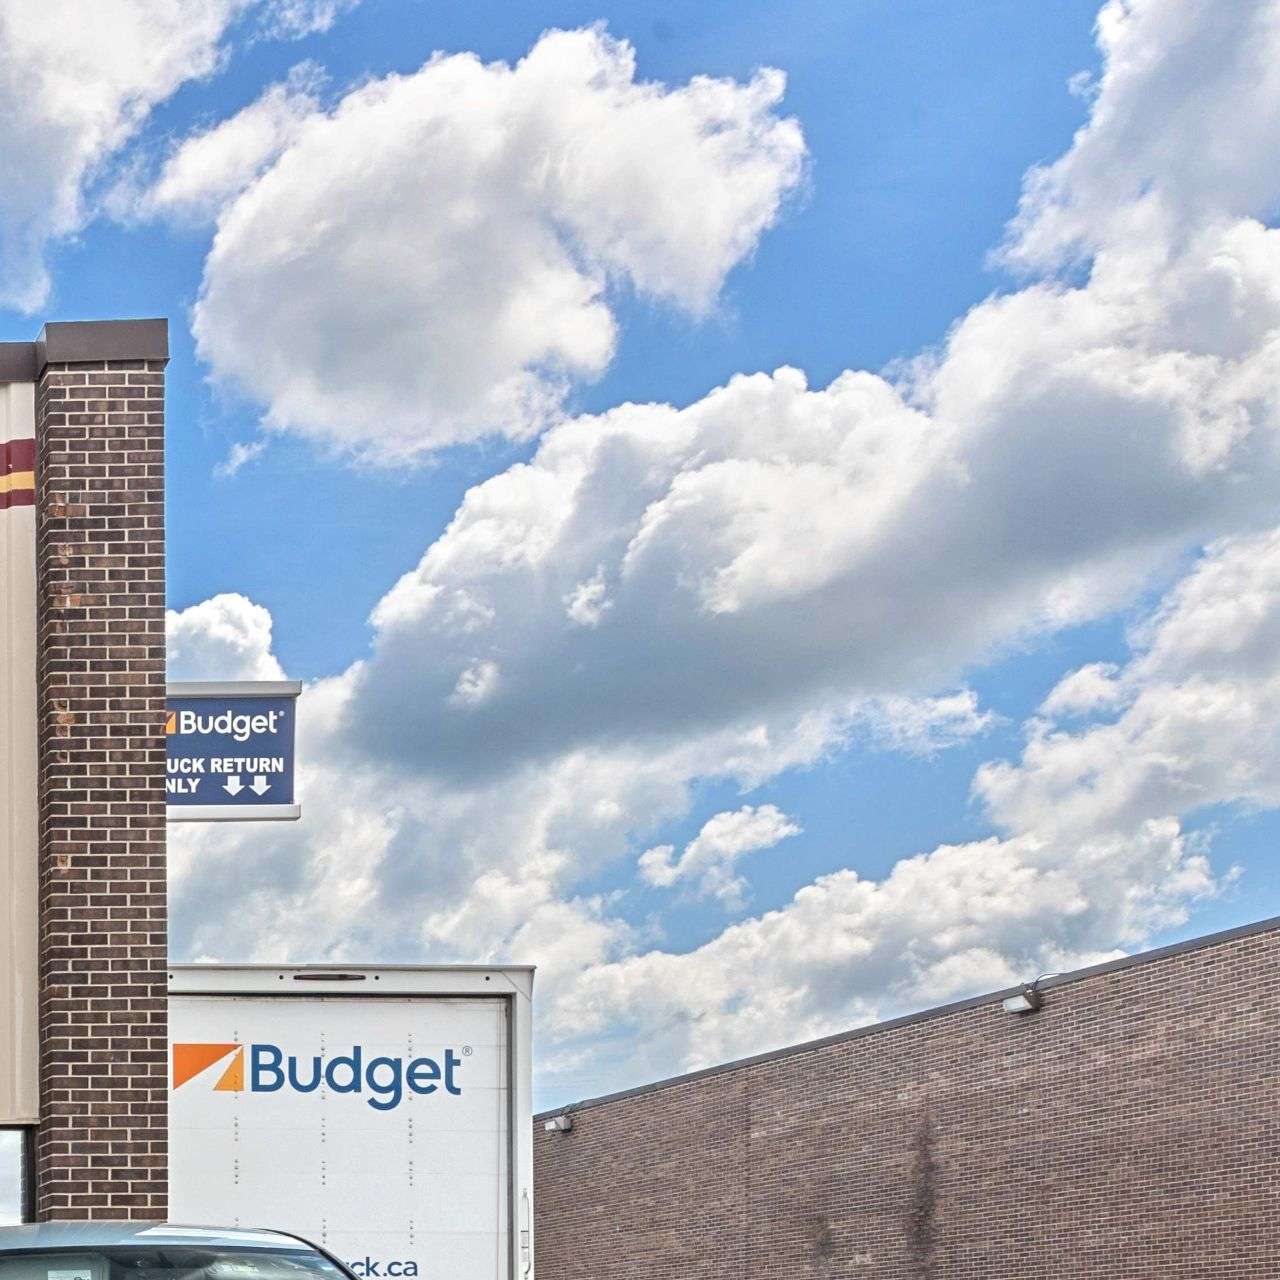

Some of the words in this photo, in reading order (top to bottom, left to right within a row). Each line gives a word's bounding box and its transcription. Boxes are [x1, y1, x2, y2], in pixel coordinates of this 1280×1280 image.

[180, 710, 278, 742] Budget
[166, 757, 205, 773] UCK
[210, 757, 284, 773] RETURN
[166, 778, 201, 794] NLY
[251, 1044, 462, 1111] Budget
[347, 1256, 418, 1277] ck.ca
